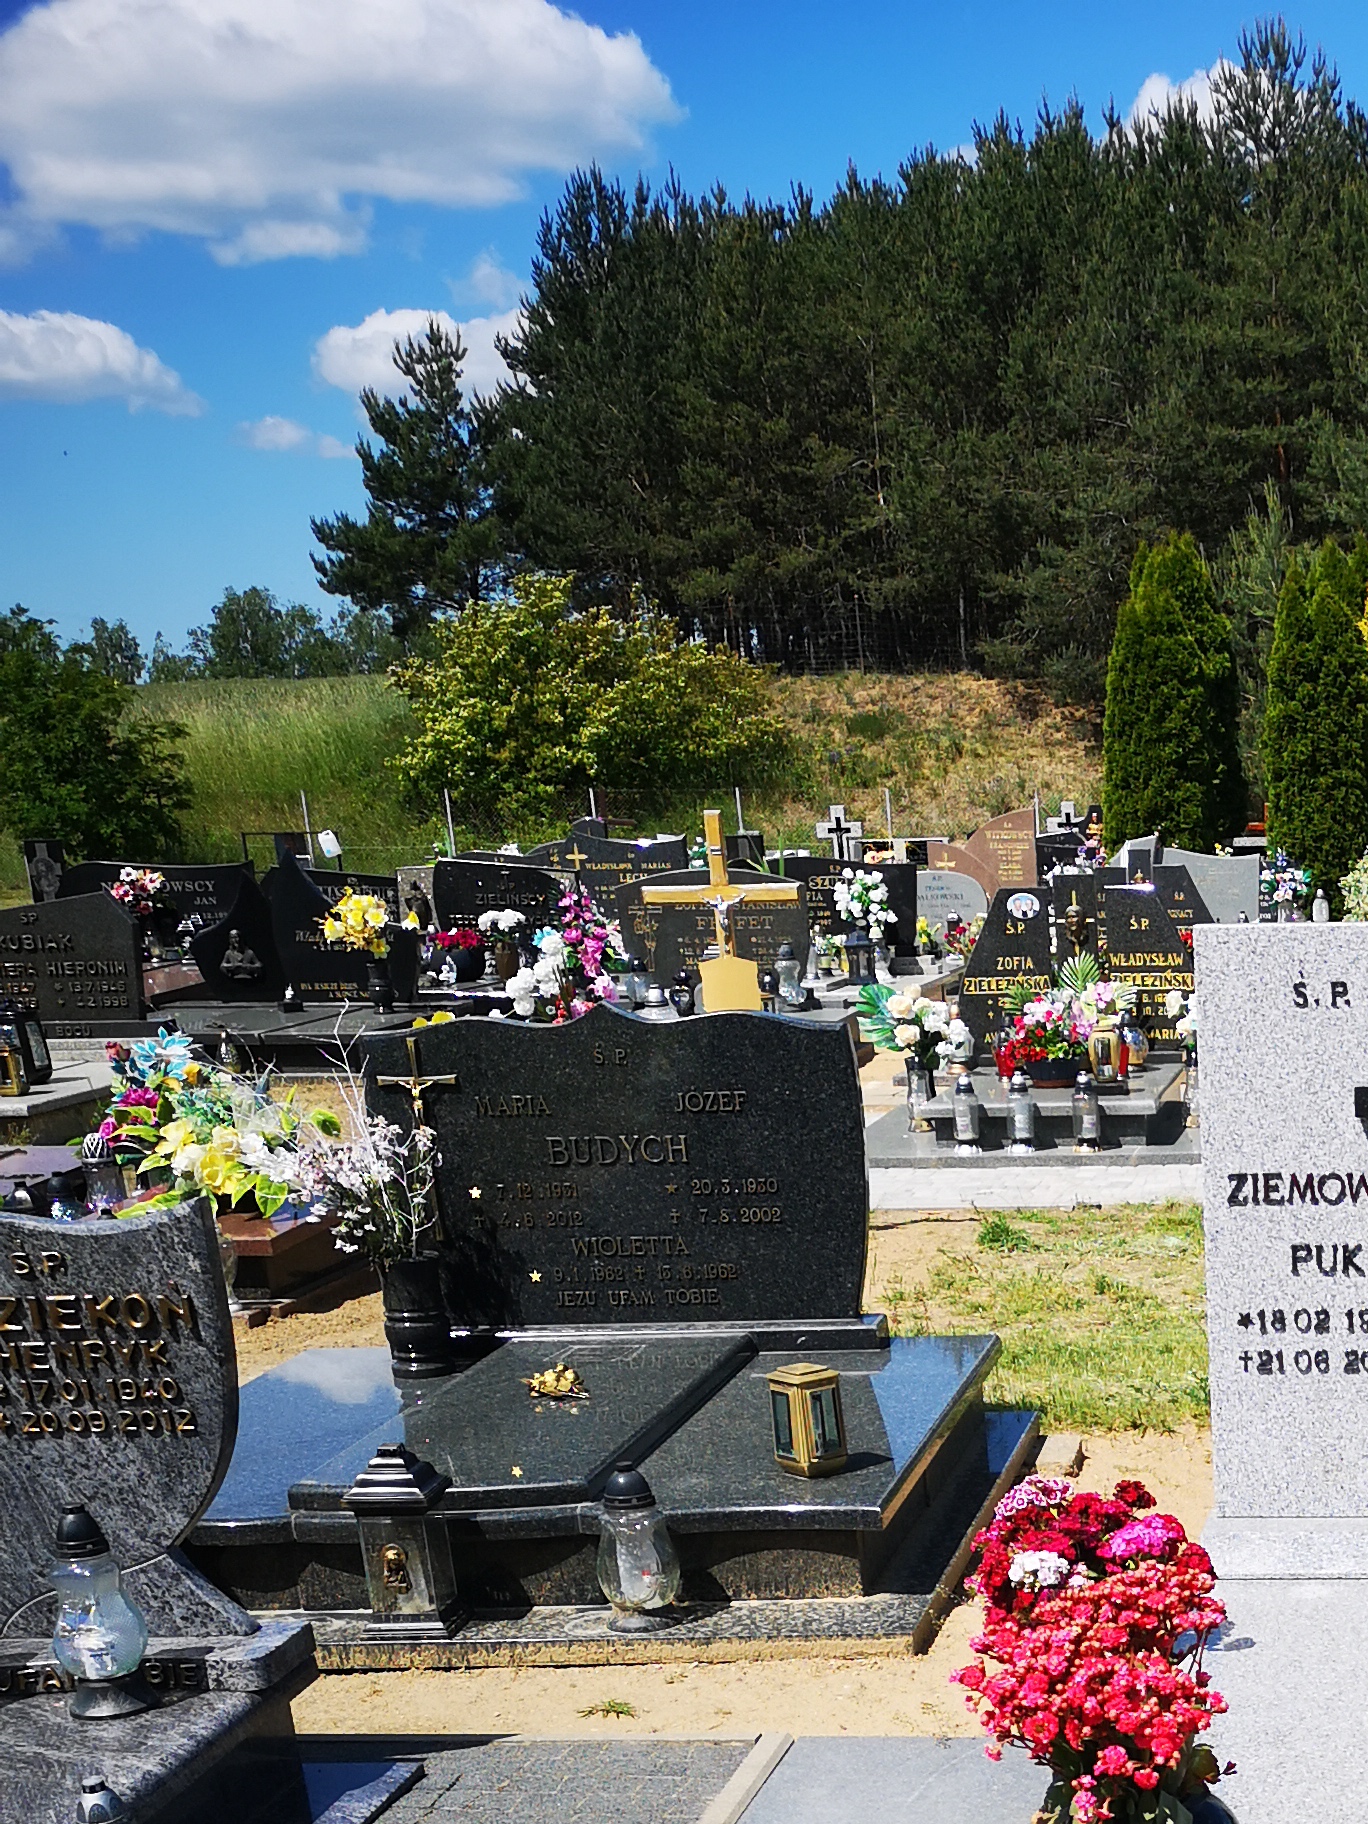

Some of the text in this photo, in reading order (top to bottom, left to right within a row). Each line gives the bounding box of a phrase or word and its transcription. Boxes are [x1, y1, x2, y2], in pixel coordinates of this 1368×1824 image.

[193, 896, 217, 905] JAN
[997, 956, 1035, 971] ZOFIA
[1108, 952, 1184, 967] WŁADYSŁAW
[476, 1087, 746, 1116] MARIA JÓZEF
[546, 1134, 689, 1165] BUDYCH
[571, 1236, 691, 1257] WIOLETTA
[1290, 1243, 1367, 1279] PUK
[556, 1288, 719, 1307] JEZU UFAM TOBIE
